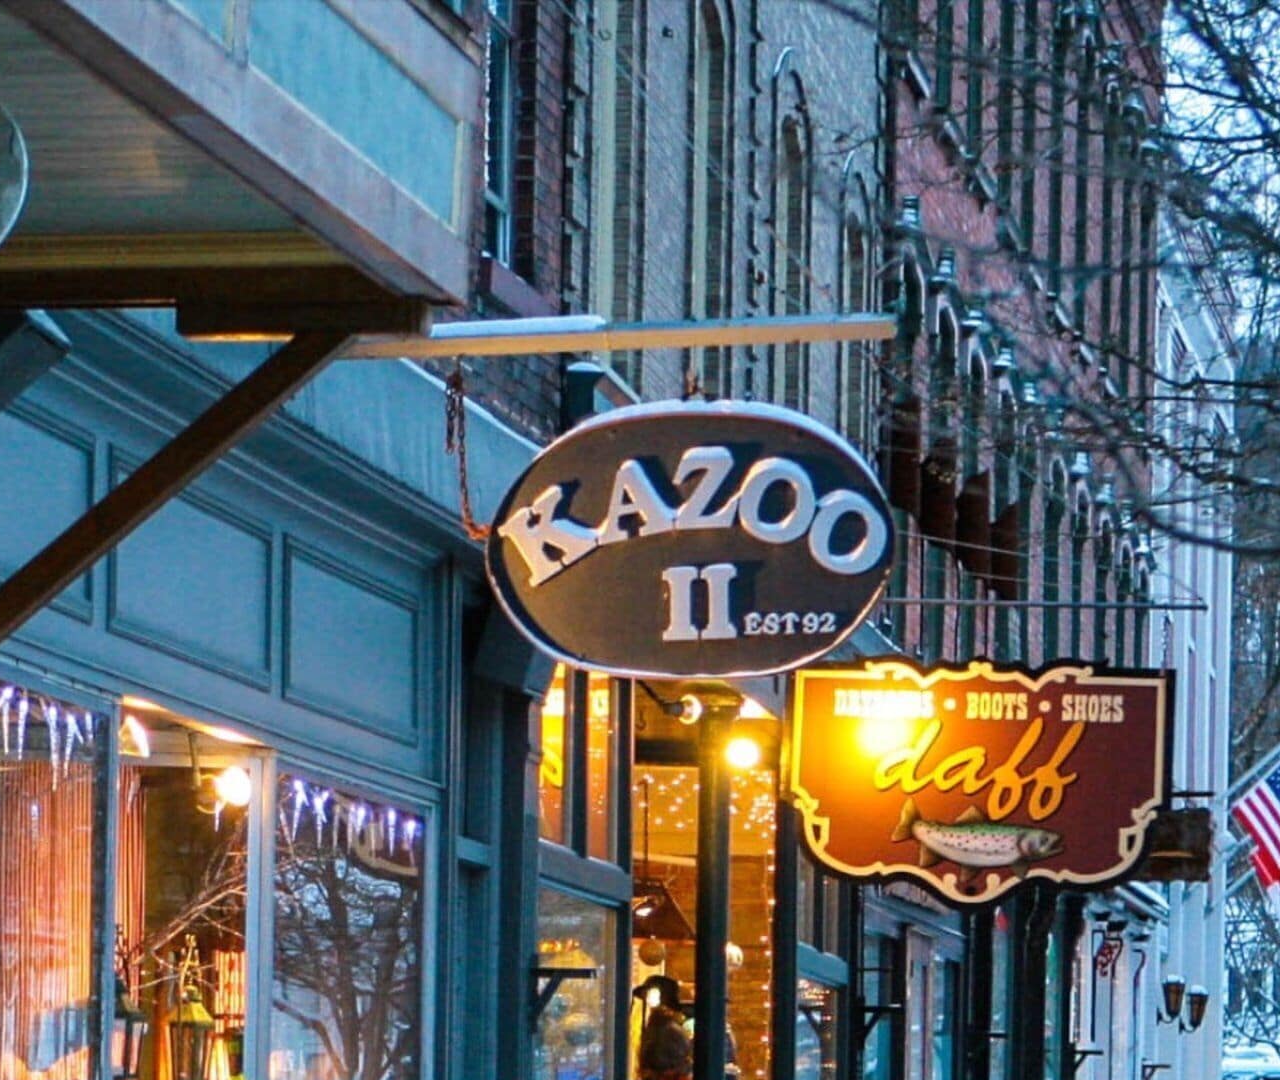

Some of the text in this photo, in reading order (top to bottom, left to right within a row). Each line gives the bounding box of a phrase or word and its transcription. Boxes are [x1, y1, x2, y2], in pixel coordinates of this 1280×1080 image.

[497, 445, 888, 588] KAZOO
[662, 562, 837, 642] II EST 92
[965, 691, 1029, 721] BOOTS
[1061, 693, 1125, 723] SHOES
[873, 716, 1086, 822] daff
